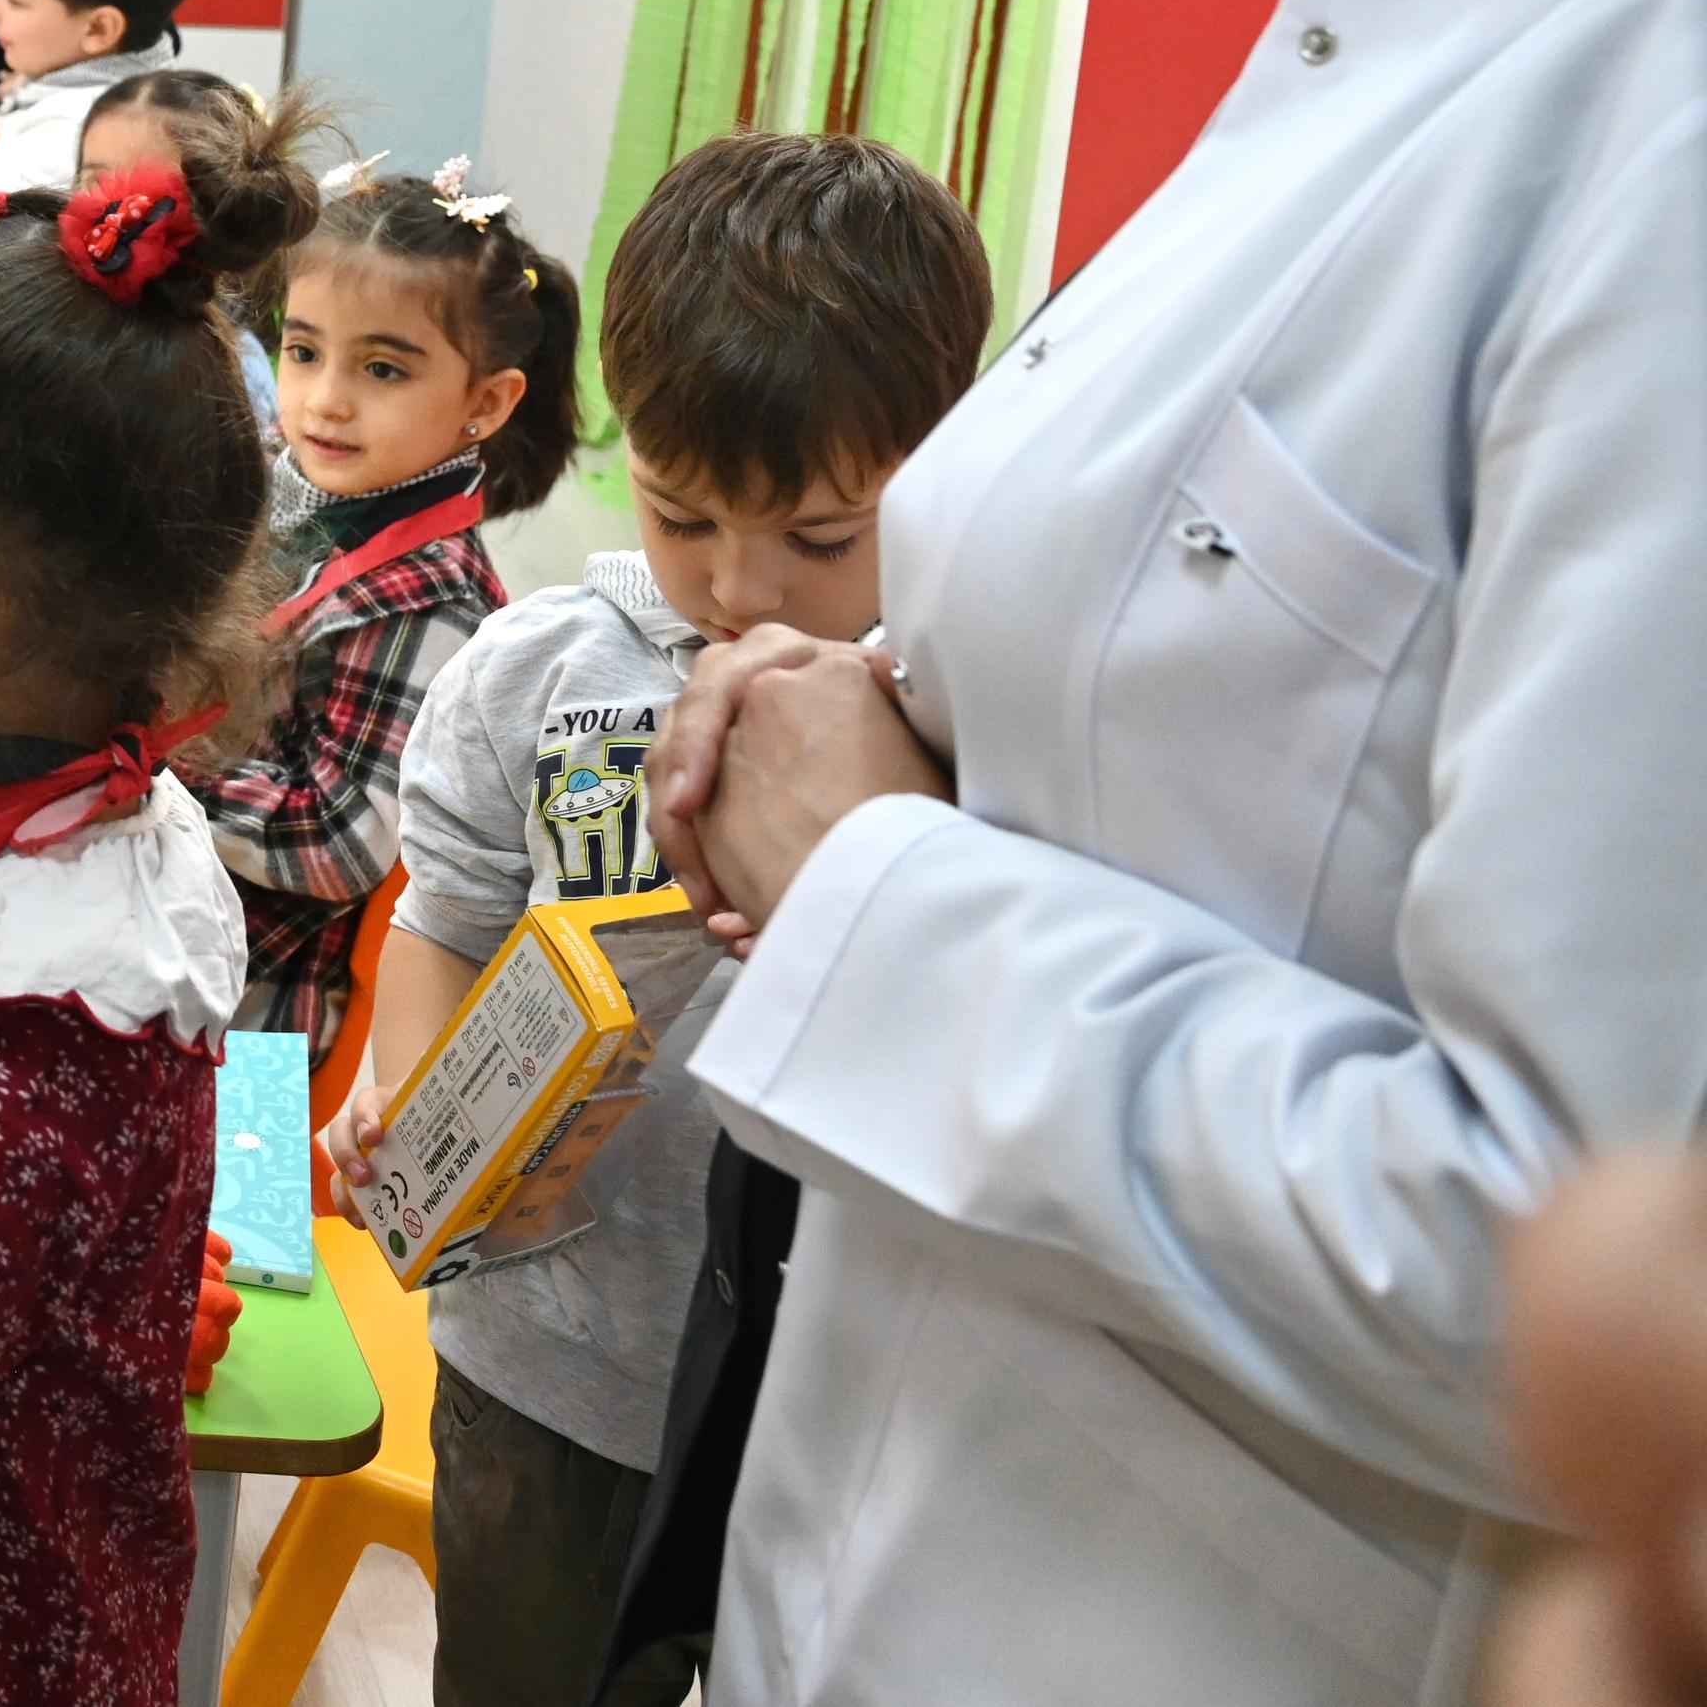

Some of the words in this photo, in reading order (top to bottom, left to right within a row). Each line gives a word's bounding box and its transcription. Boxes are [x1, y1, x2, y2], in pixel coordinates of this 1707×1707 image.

[423, 1130, 457, 1177] WARNING:
[453, 1136, 480, 1173] MADE
[444, 1166, 457, 1185] IN
[421, 1178, 448, 1215] CHINA
